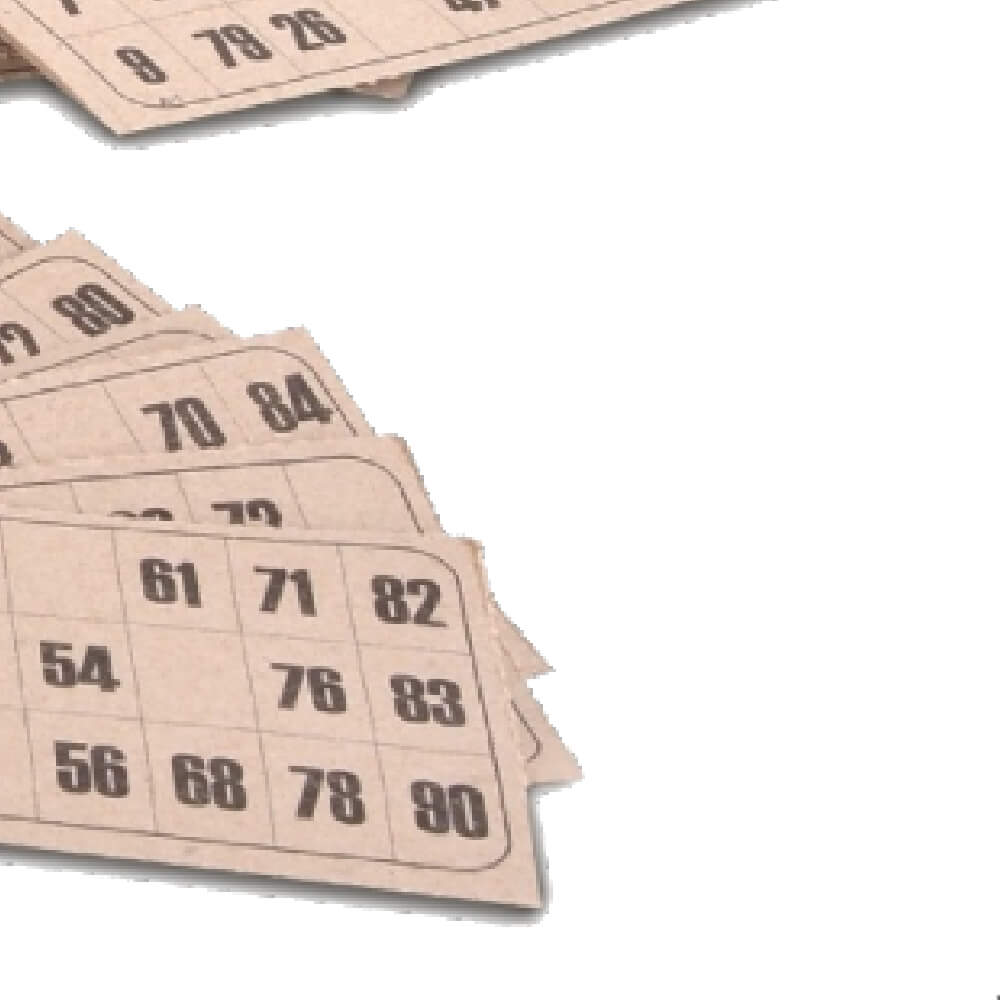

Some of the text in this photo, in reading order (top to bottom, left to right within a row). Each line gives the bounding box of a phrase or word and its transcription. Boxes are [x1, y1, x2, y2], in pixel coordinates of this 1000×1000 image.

[268, 7, 347, 51] 26
[51, 283, 137, 338] 80
[140, 397, 228, 454] 70
[245, 370, 334, 434] 84
[139, 558, 202, 609] 61
[252, 565, 318, 618] 71
[371, 574, 447, 628] 82
[39, 639, 121, 693] 54
[271, 662, 347, 715] 76
[390, 674, 466, 728] 83
[55, 739, 131, 799] 56
[171, 752, 247, 812] 68
[287, 765, 366, 825] 78
[410, 781, 489, 841] 90
